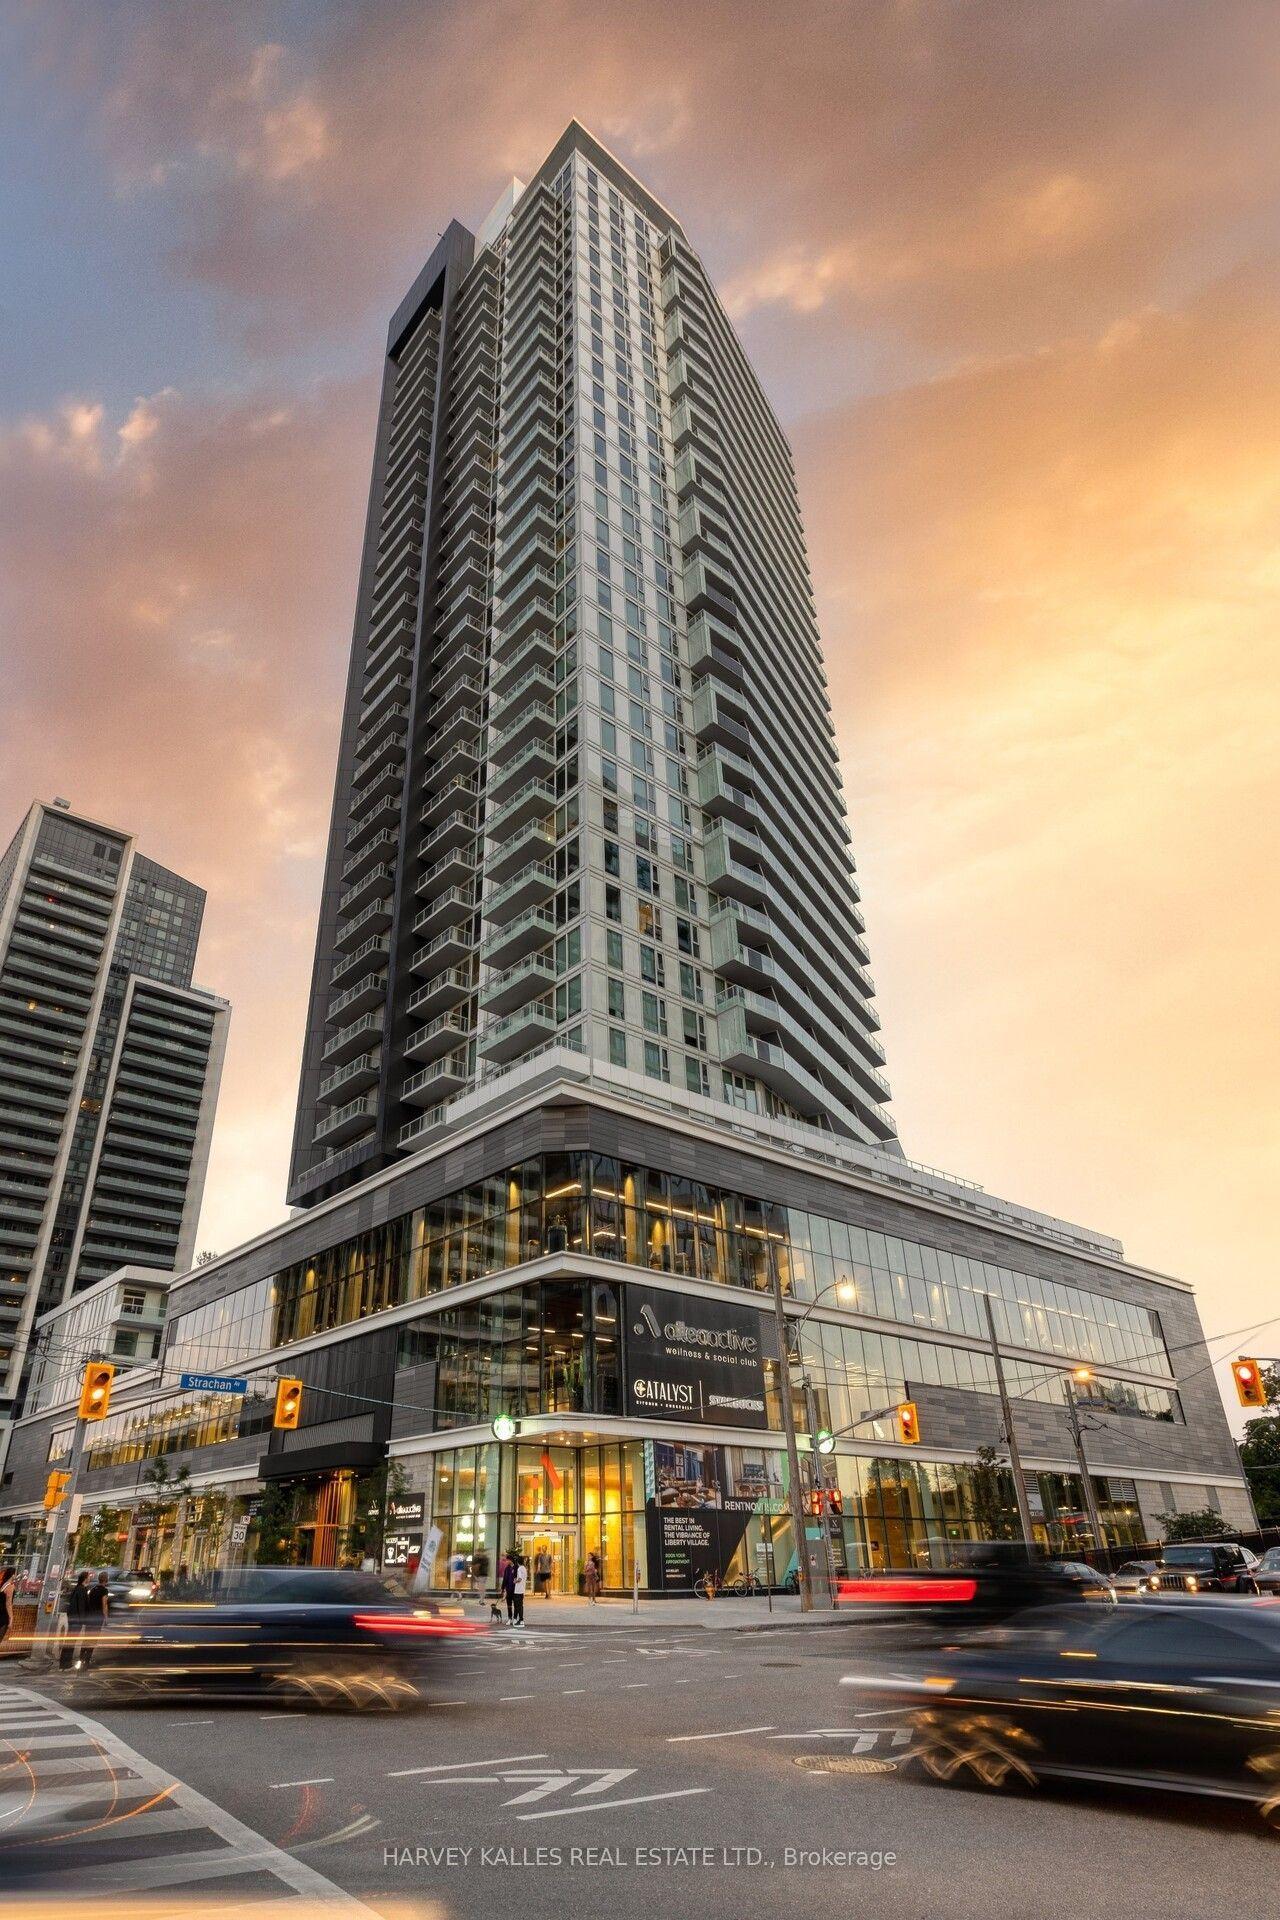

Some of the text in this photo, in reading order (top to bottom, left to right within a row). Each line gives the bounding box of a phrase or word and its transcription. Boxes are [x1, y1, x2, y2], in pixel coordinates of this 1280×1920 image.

[665, 1346, 758, 1367] wellness & social club
[188, 1376, 232, 1390] Strachan
[633, 1379, 693, 1404] CATALYST
[233, 1531, 245, 1541] 30
